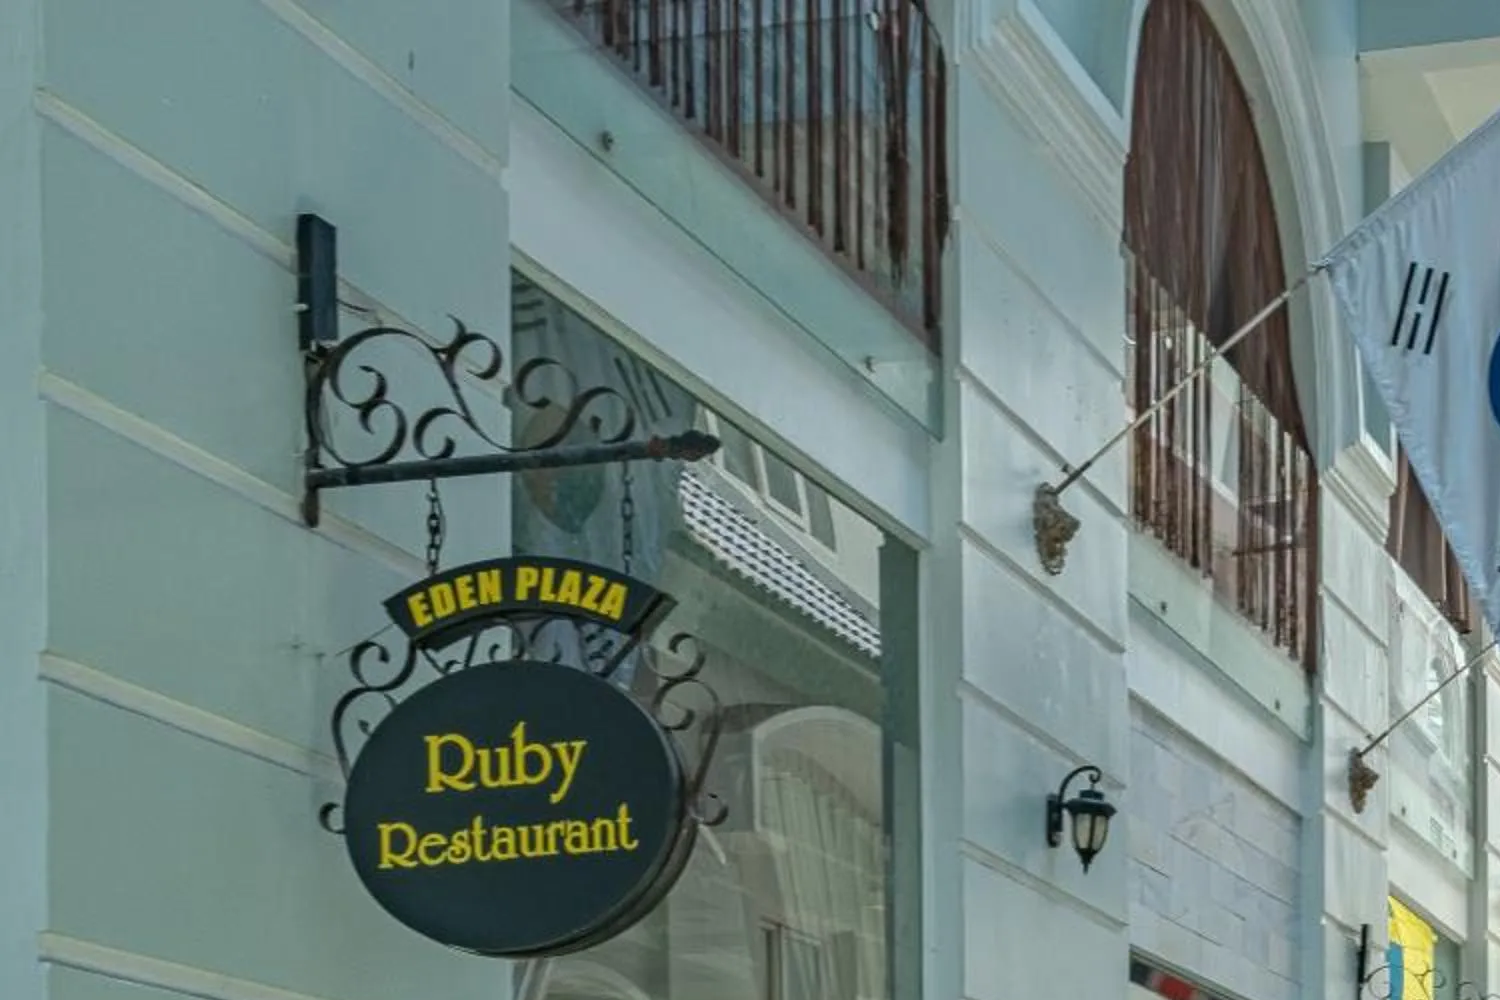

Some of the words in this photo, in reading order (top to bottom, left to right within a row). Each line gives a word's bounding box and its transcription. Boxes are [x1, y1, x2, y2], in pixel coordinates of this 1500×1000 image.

[407, 569, 503, 627] EDEN
[515, 565, 628, 621] PLAZA
[423, 721, 588, 804] Ruby
[376, 803, 639, 869] Restaurant
